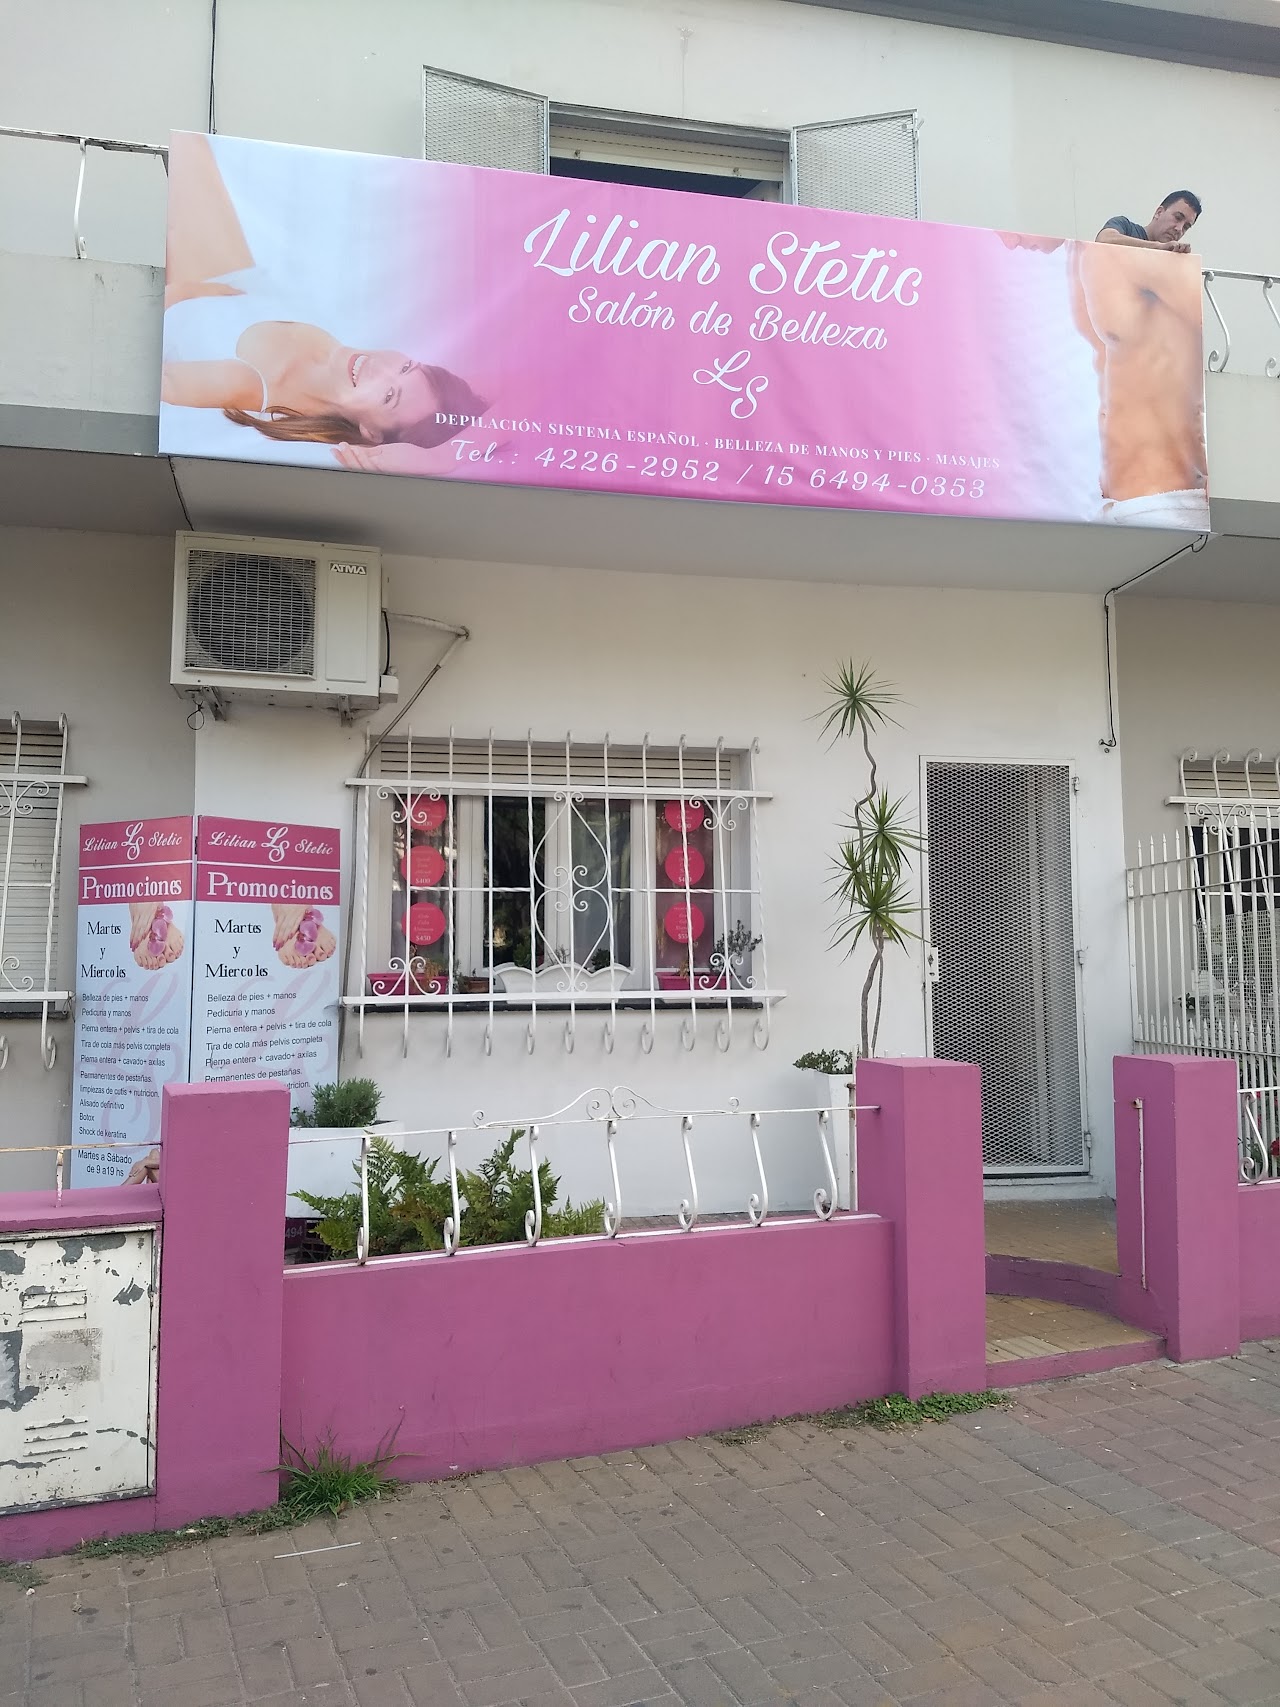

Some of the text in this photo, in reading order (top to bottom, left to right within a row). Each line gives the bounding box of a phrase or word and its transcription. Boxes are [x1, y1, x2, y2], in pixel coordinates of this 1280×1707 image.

[523, 208, 923, 307] Lilian Stetic
[568, 286, 888, 350] Salón de Belleza
[435, 412, 542, 433] DEPILACIÓN
[548, 423, 622, 441] SISTEMA
[627, 430, 700, 447] ESPAÑOL
[714, 438, 784, 453] BELLEZA
[789, 443, 810, 456] DE
[815, 445, 870, 460] MANOS
[873, 450, 883, 461] Y
[888, 450, 922, 464] PIES
[936, 453, 1001, 469] MASAJES
[451, 439, 519, 465] Tel.:
[535, 447, 720, 483] 4226-2952
[810, 468, 986, 499] 6494-0353
[330, 563, 367, 576] ATMA
[82, 837, 118, 852] Lilian
[148, 831, 183, 847] Stetic
[207, 831, 257, 849] Lilian
[294, 838, 333, 855] Stetic
[82, 876, 182, 899] Promociones
[207, 871, 334, 900] Promociones
[87, 921, 122, 935] Martes
[214, 918, 262, 934] Martes
[99, 947, 106, 960] y
[232, 945, 241, 959] y
[82, 993, 101, 1001] Belleza
[111, 994, 122, 1003] pies
[207, 994, 236, 1002] Belleza
[238, 993, 247, 1001] de
[249, 993, 264, 1002] pies
[273, 992, 296, 1000] manos
[82, 1008, 106, 1016] Pedicuria
[108, 1010, 111, 1018] y
[207, 1009, 242, 1018] Pedicuria
[81, 1024, 98, 1032] Pierna
[124, 1026, 140, 1034] pelvis
[158, 1026, 165, 1034] de
[206, 1026, 231, 1034] Pierna
[234, 1025, 257, 1033] entera
[266, 1022, 286, 1032] pelvis
[295, 1020, 306, 1028] tira
[308, 1020, 316, 1028] de
[318, 1019, 332, 1027] cola
[126, 1042, 142, 1051] pelvis
[144, 1043, 170, 1052] completa
[206, 1036, 322, 1051] Tira de cola más pelvis completa
[81, 1055, 98, 1063] Pierna
[99, 1056, 116, 1064] entera
[148, 1058, 165, 1066] axilas
[206, 1058, 230, 1066] Pierna
[232, 1056, 256, 1064] entera
[297, 1050, 317, 1058] axilas
[80, 1071, 115, 1080] Permanentes
[205, 1072, 255, 1082] Permanentes
[258, 1070, 267, 1079] de
[80, 1099, 124, 1109] Alisado definitivo
[80, 1113, 94, 1122] Botox
[79, 1127, 95, 1136] Shock
[105, 1130, 127, 1138] keratina
[78, 1150, 99, 1160] Martes
[107, 1152, 132, 1164] Sábado
[87, 1164, 94, 1173] de
[96, 1165, 100, 1174] 9
[116, 1167, 124, 1177] hs
